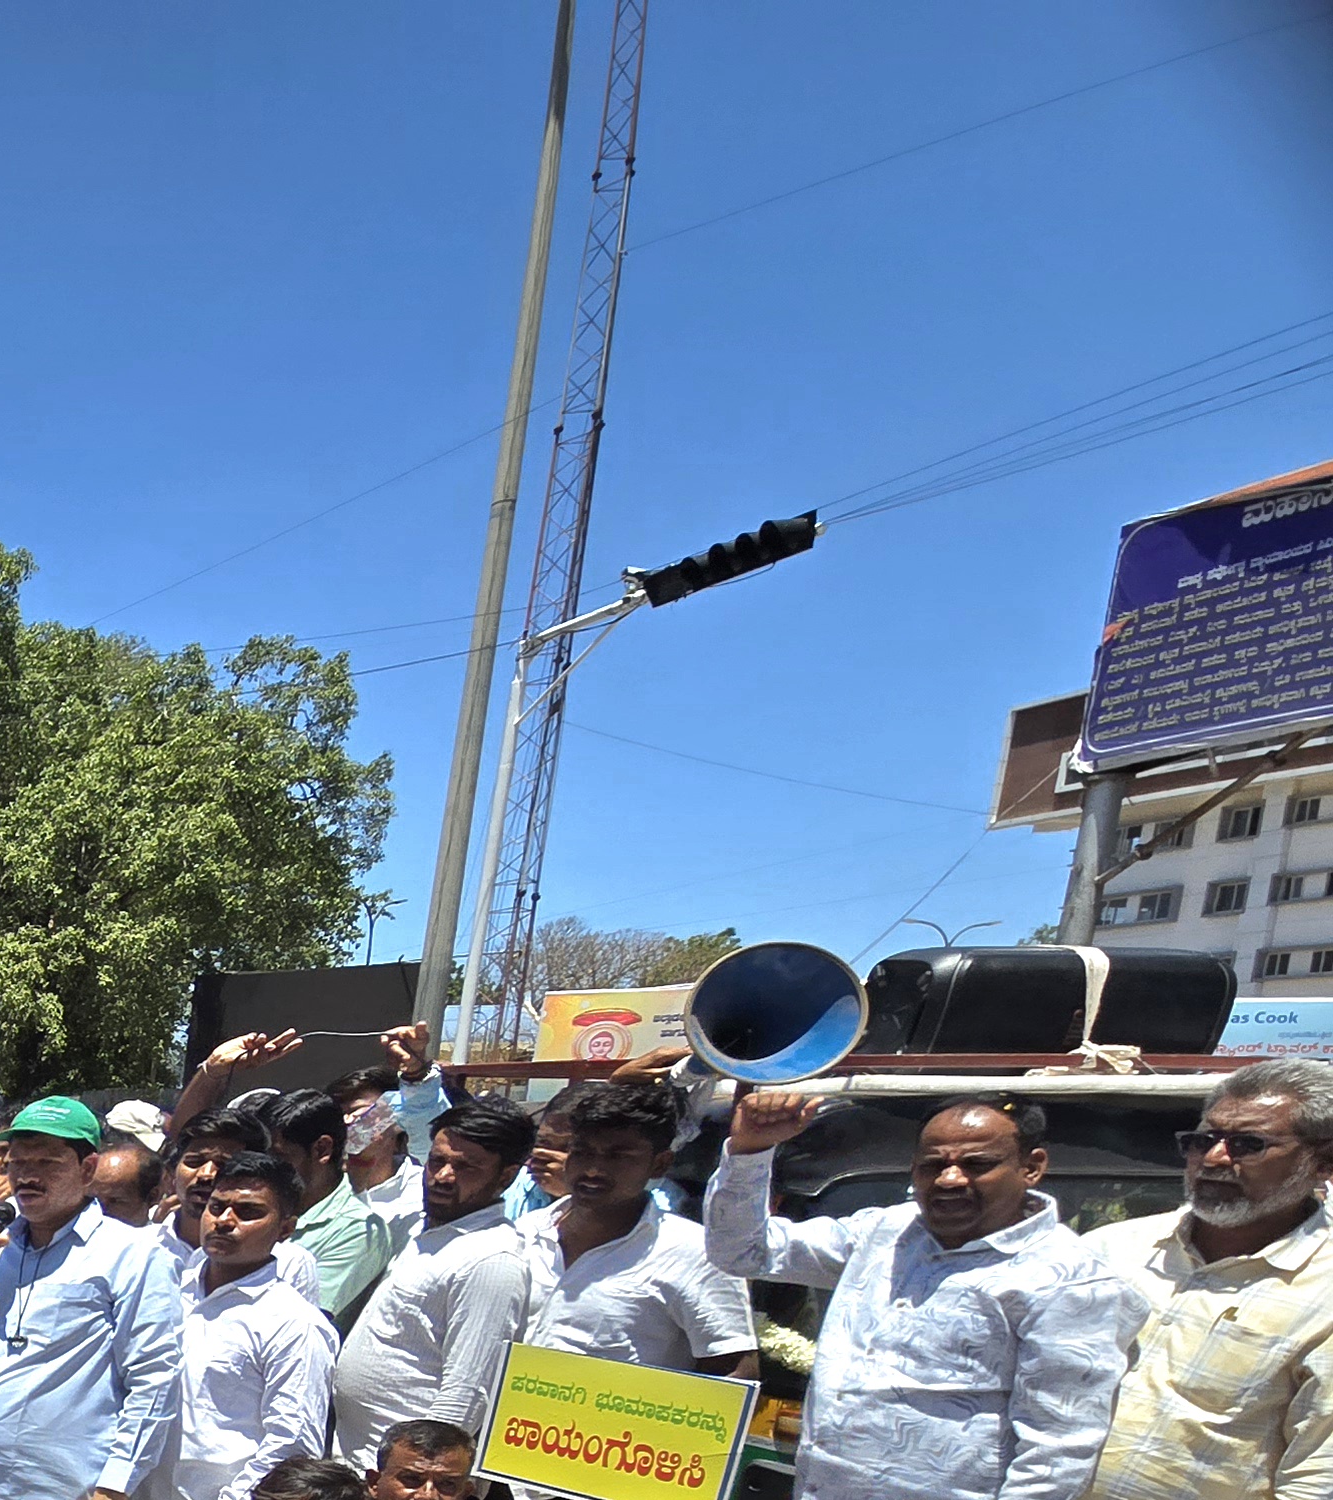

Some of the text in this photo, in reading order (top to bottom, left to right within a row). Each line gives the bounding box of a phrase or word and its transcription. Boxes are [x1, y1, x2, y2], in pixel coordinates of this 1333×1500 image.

[1254, 1011, 1299, 1024] Cook
[510, 1372, 728, 1444] ಪರವಾನಗಿ ಭೂಮಾಪಕರನ್ನು
[503, 1415, 708, 1489] ಖಾಯಂಗೊಳಿಸಿ
